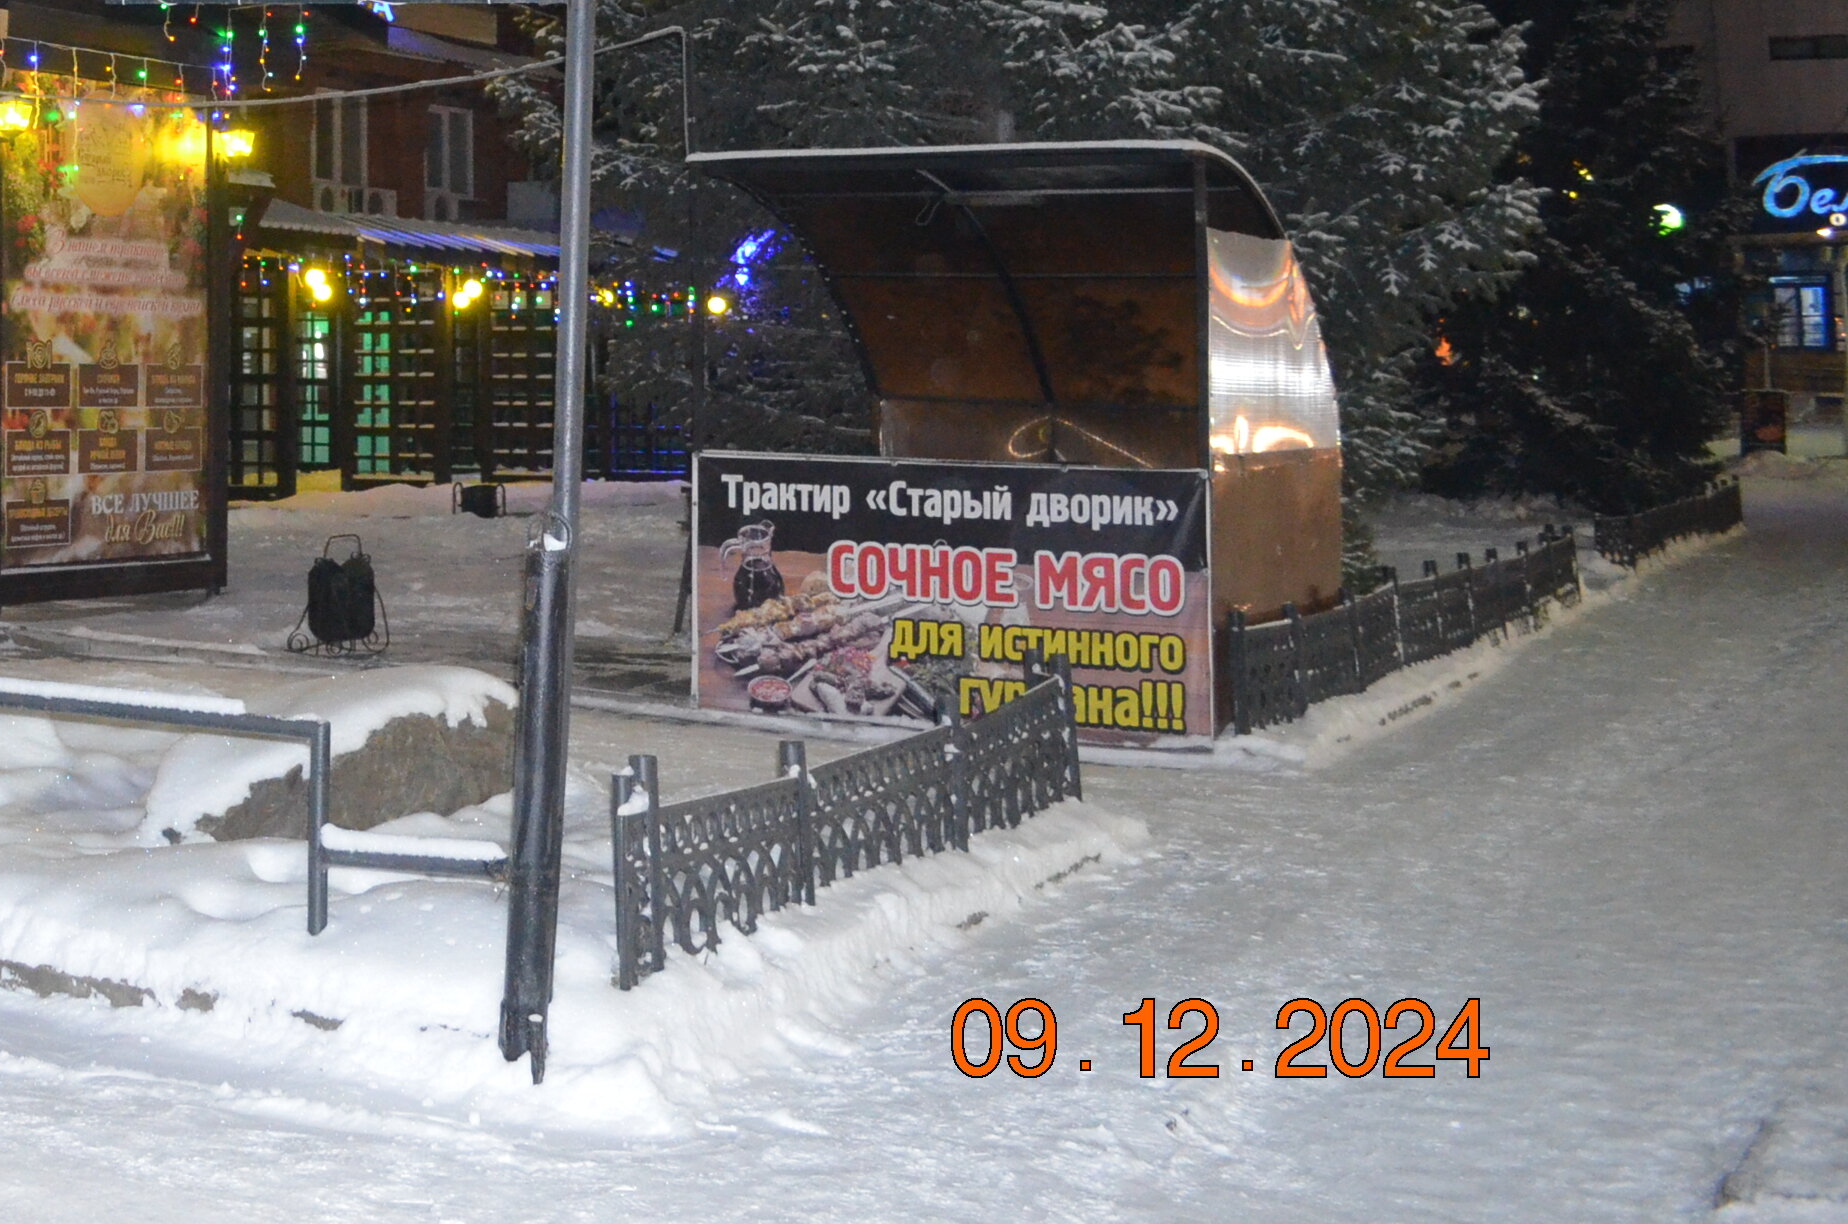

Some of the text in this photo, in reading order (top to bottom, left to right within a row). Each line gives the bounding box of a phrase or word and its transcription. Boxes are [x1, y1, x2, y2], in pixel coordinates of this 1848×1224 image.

[91, 493, 125, 515] ВСЕ
[128, 489, 199, 513] ЛУЧШЕЕ
[721, 473, 1180, 531] Трактир «Старый дворик»
[827, 539, 1185, 617] СОЧНОЕ МЯСО
[889, 618, 1186, 674] для истинного
